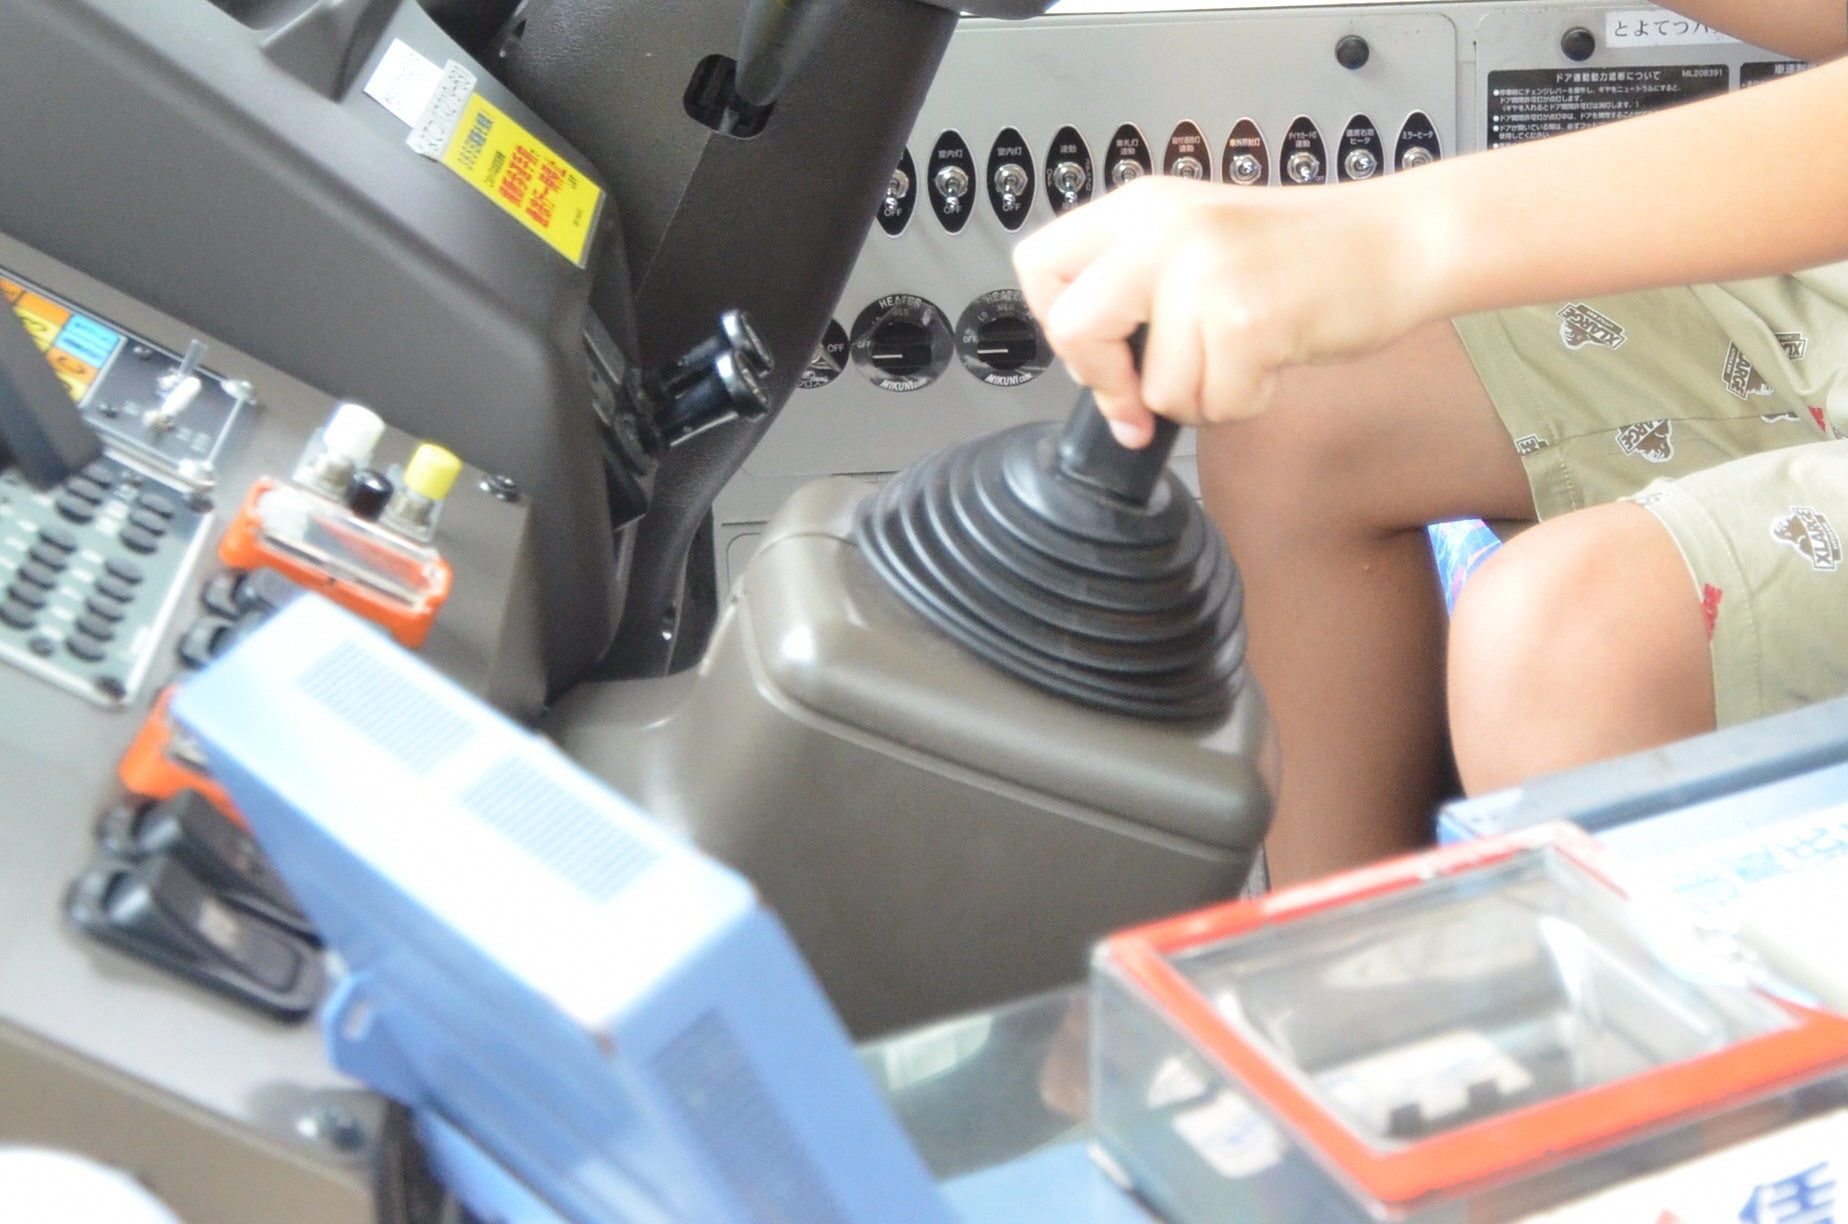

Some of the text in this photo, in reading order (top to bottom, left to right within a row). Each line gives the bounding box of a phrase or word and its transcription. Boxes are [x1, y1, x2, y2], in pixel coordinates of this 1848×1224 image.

[884, 208, 903, 217] OFF
[943, 206, 962, 215] OFF
[1002, 203, 1021, 212] OFF
[878, 295, 922, 309] HEATER
[1562, 307, 1620, 348] XLARGE
[827, 343, 845, 353] OFF
[1795, 508, 1832, 565] XLARGE
